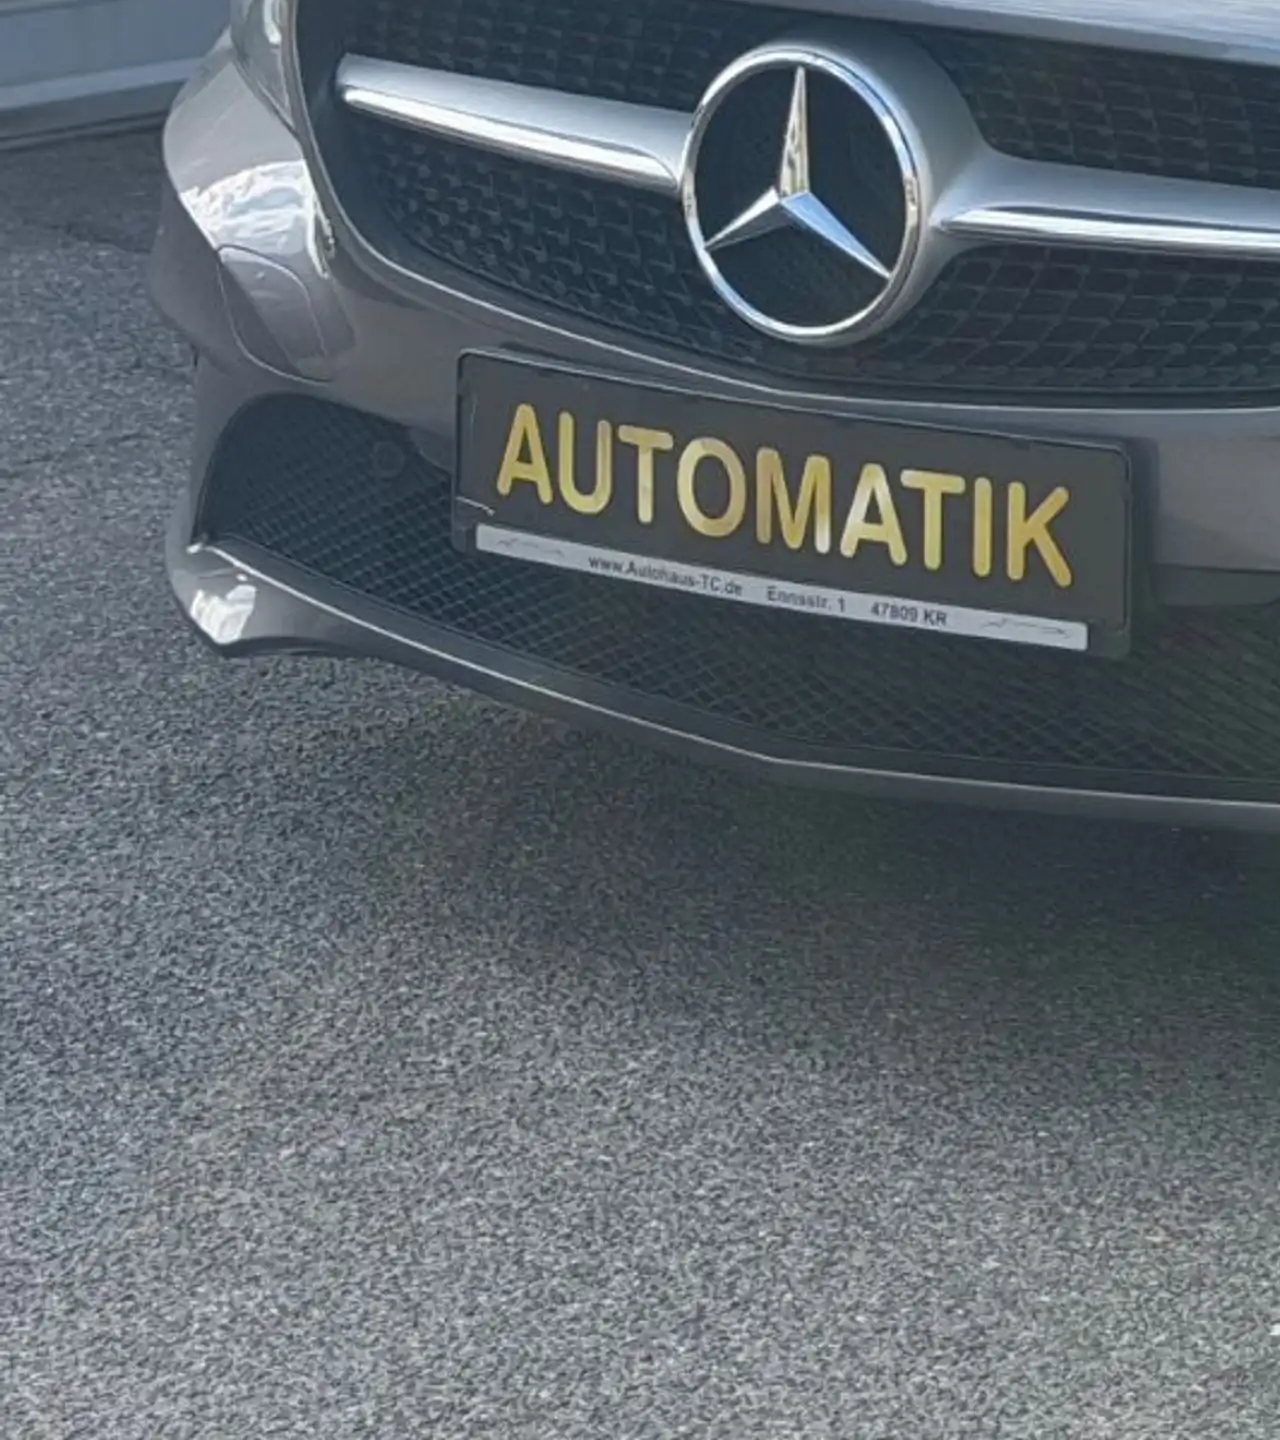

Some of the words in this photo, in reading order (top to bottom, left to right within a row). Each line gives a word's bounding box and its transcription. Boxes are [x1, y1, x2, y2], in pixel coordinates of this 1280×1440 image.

[497, 402, 1073, 588] AUTOMATIK
[587, 555, 744, 597] www.Autohaus-TC.de
[870, 600, 919, 622] 47809
[923, 609, 949, 627] KR
